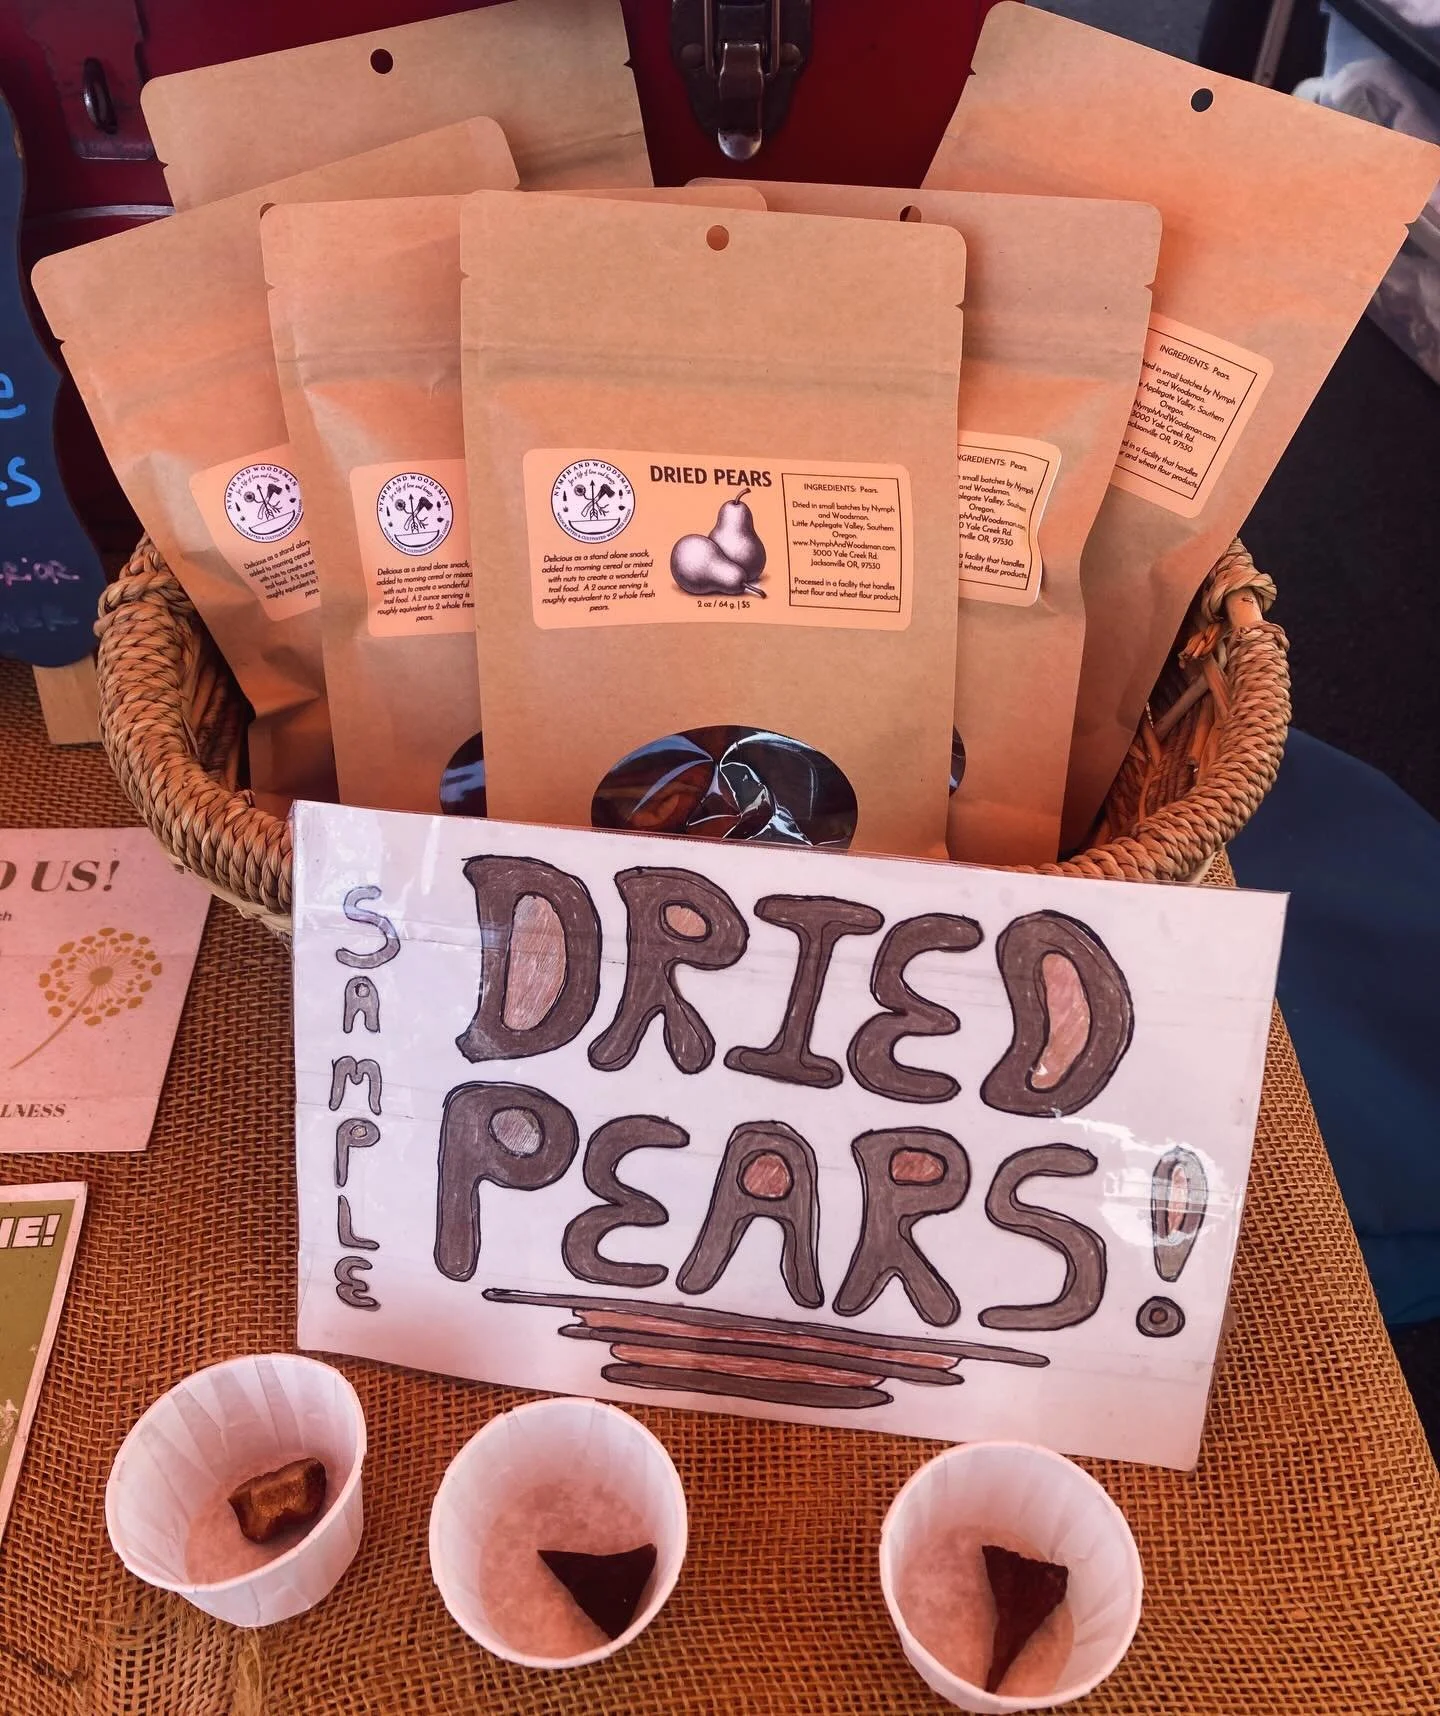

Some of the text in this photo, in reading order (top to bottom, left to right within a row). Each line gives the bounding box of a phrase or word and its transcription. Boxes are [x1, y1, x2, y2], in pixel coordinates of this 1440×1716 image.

[1143, 359, 1156, 370] ried
[1162, 369, 1179, 379] small
[1179, 374, 1202, 390] batches
[1203, 385, 1211, 395] by
[1213, 390, 1236, 405] Nymph
[1157, 379, 1169, 387] and
[1144, 382, 1175, 400] Applegate
[1198, 406, 1224, 422] Southern
[1133, 399, 1216, 441] NymphAndWoodsman.com.
[1128, 421, 1158, 437] acksonville
[1152, 418, 1165, 429] Yale
[1166, 425, 1183, 438] Creek
[1125, 453, 1138, 461] and
[1139, 458, 1157, 470] wheat
[1158, 465, 1171, 476] flour
[1142, 447, 1161, 461] facility
[1162, 456, 1175, 467] that
[1175, 461, 1198, 477] handles
[554, 462, 631, 496] NYMPH AND WOODSMAN
[650, 465, 772, 487] DRIED PEARS
[804, 483, 856, 492] INGREDIENTS:
[981, 475, 1005, 485] batches
[1007, 479, 1014, 488] by
[1014, 482, 1034, 495] Nymph
[379, 475, 449, 512] NYMPH AND WOODSMAN
[862, 504, 870, 512] by
[871, 505, 895, 513] Nymph
[809, 520, 842, 529] Applegate
[844, 522, 865, 530] Valley,
[867, 523, 894, 531] Southern
[590, 552, 608, 560] stand
[833, 550, 847, 558] Yale
[378, 567, 402, 575] Delicious
[417, 563, 432, 571] stand
[433, 562, 448, 570] alone
[542, 565, 564, 573] added
[574, 564, 600, 572] morning
[603, 562, 623, 570] cereal
[633, 559, 653, 567] mixed
[811, 559, 845, 567] Jacksonville
[965, 563, 983, 572] wheat
[985, 566, 999, 574] flour
[616, 571, 648, 579] wonderful
[438, 581, 469, 589] wonderful
[794, 577, 824, 586] Processed
[839, 580, 857, 588] facility
[873, 582, 895, 590] handles
[542, 596, 566, 604] roughly
[568, 594, 602, 603] equivalent
[619, 591, 637, 599] whole
[811, 588, 824, 596] flour
[840, 590, 857, 598] wheat
[859, 590, 872, 599] flour
[31, 860, 119, 892] US!
[455, 854, 1135, 1118] DRIED
[329, 886, 402, 1312] SAMPLE
[0, 1103, 66, 1118] LNESS
[434, 1081, 1208, 1337] PEARS!
